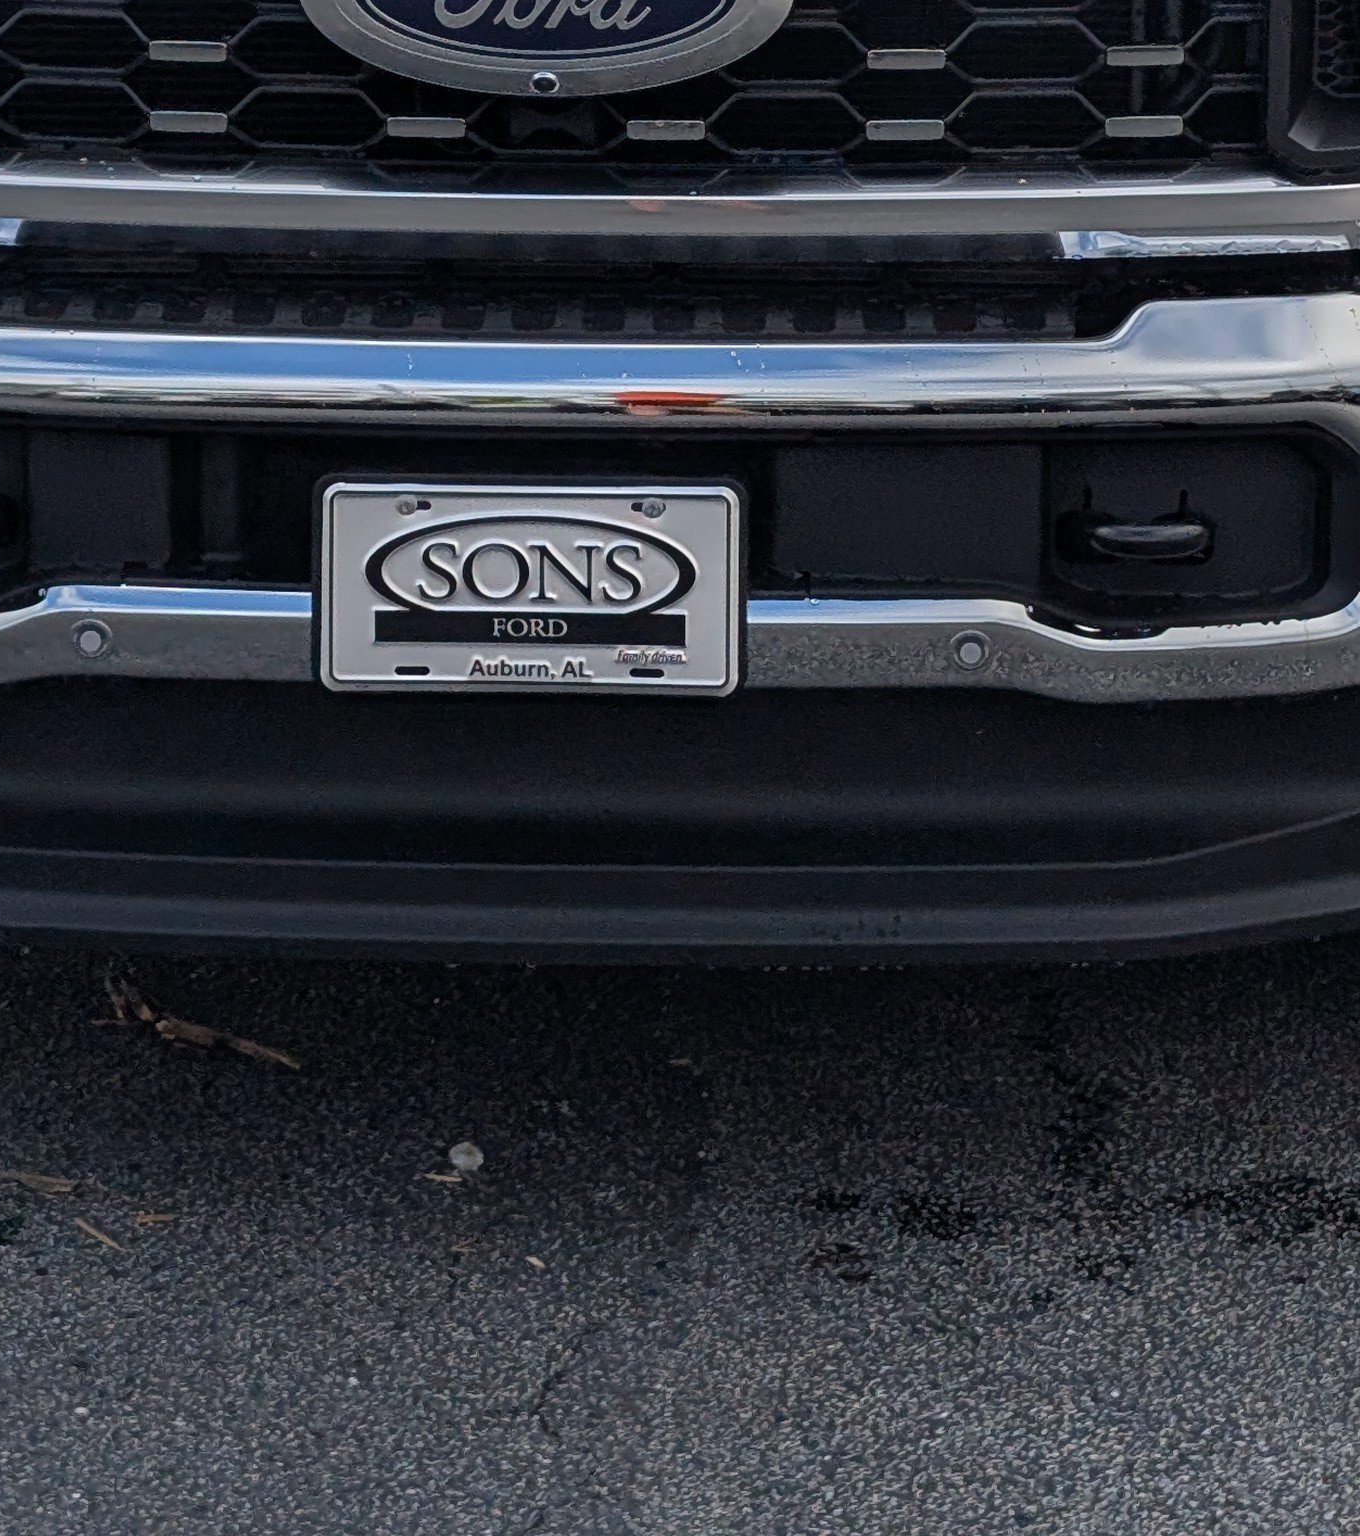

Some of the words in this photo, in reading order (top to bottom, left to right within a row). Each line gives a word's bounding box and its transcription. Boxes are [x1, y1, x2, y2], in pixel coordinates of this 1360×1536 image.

[417, 541, 642, 604] SONS
[492, 617, 568, 637] FORD
[469, 659, 556, 681] Auburn,
[561, 660, 592, 678] AL
